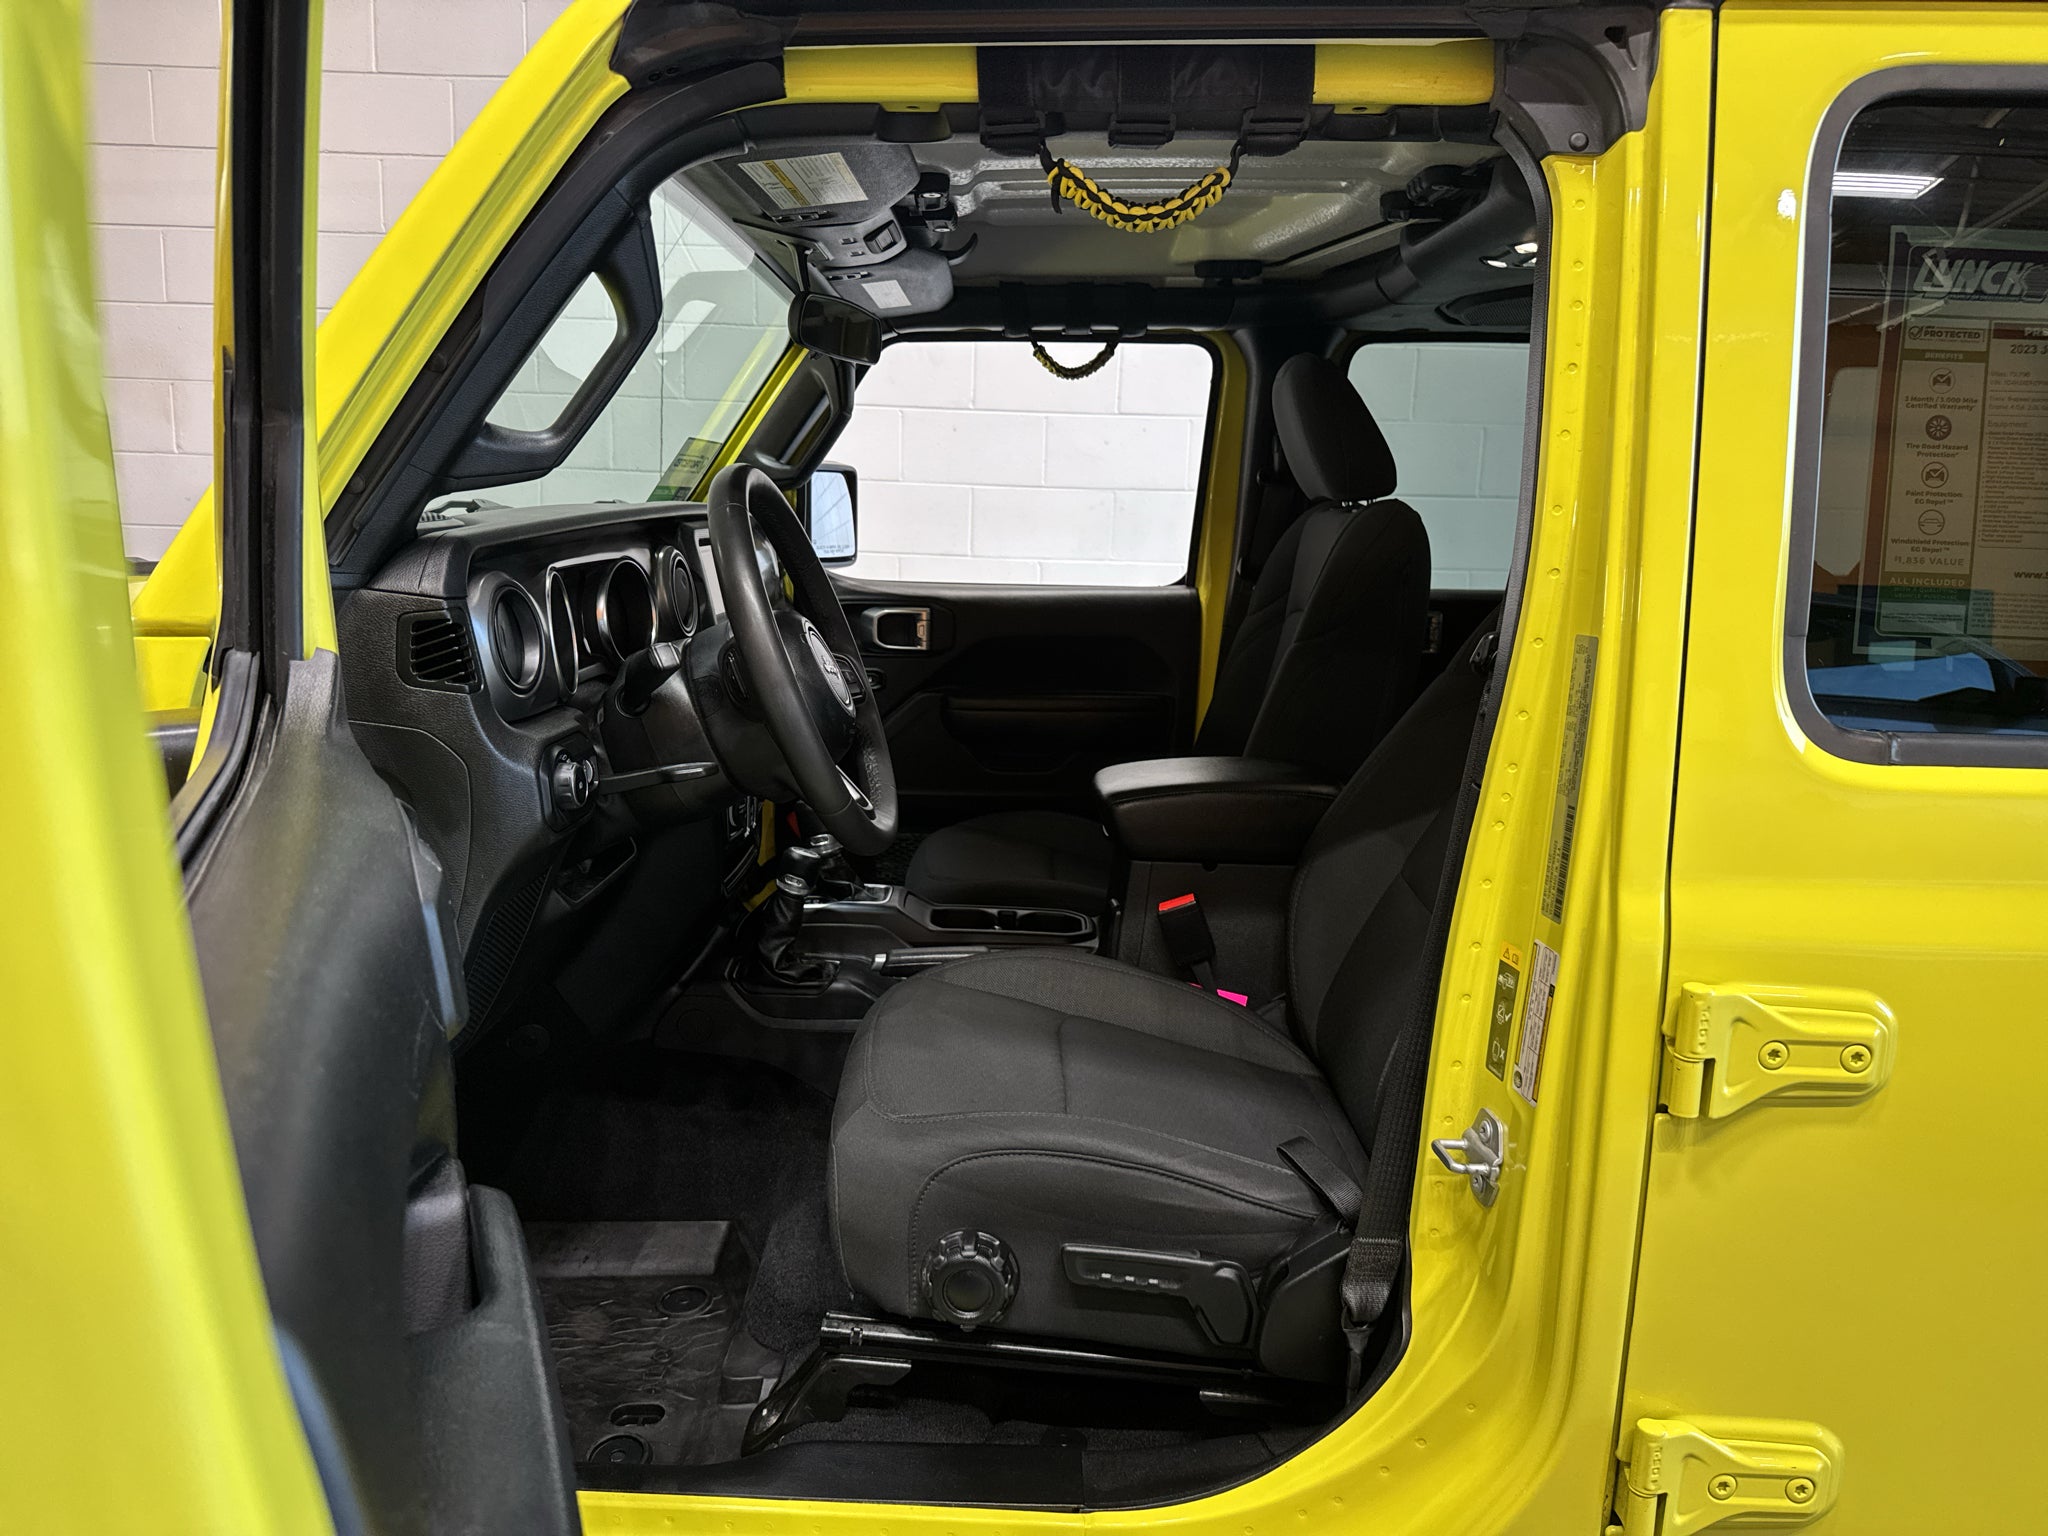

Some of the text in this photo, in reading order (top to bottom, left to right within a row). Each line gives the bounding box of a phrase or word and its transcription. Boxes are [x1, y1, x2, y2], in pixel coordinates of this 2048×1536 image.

[1924, 330, 1981, 339] PROTECTED
[2010, 344, 2037, 354] 2023
[1891, 537, 1930, 545] Windshield
[1929, 557, 1964, 566] VALUE
[1889, 577, 1965, 586] ALL INCLUDED
